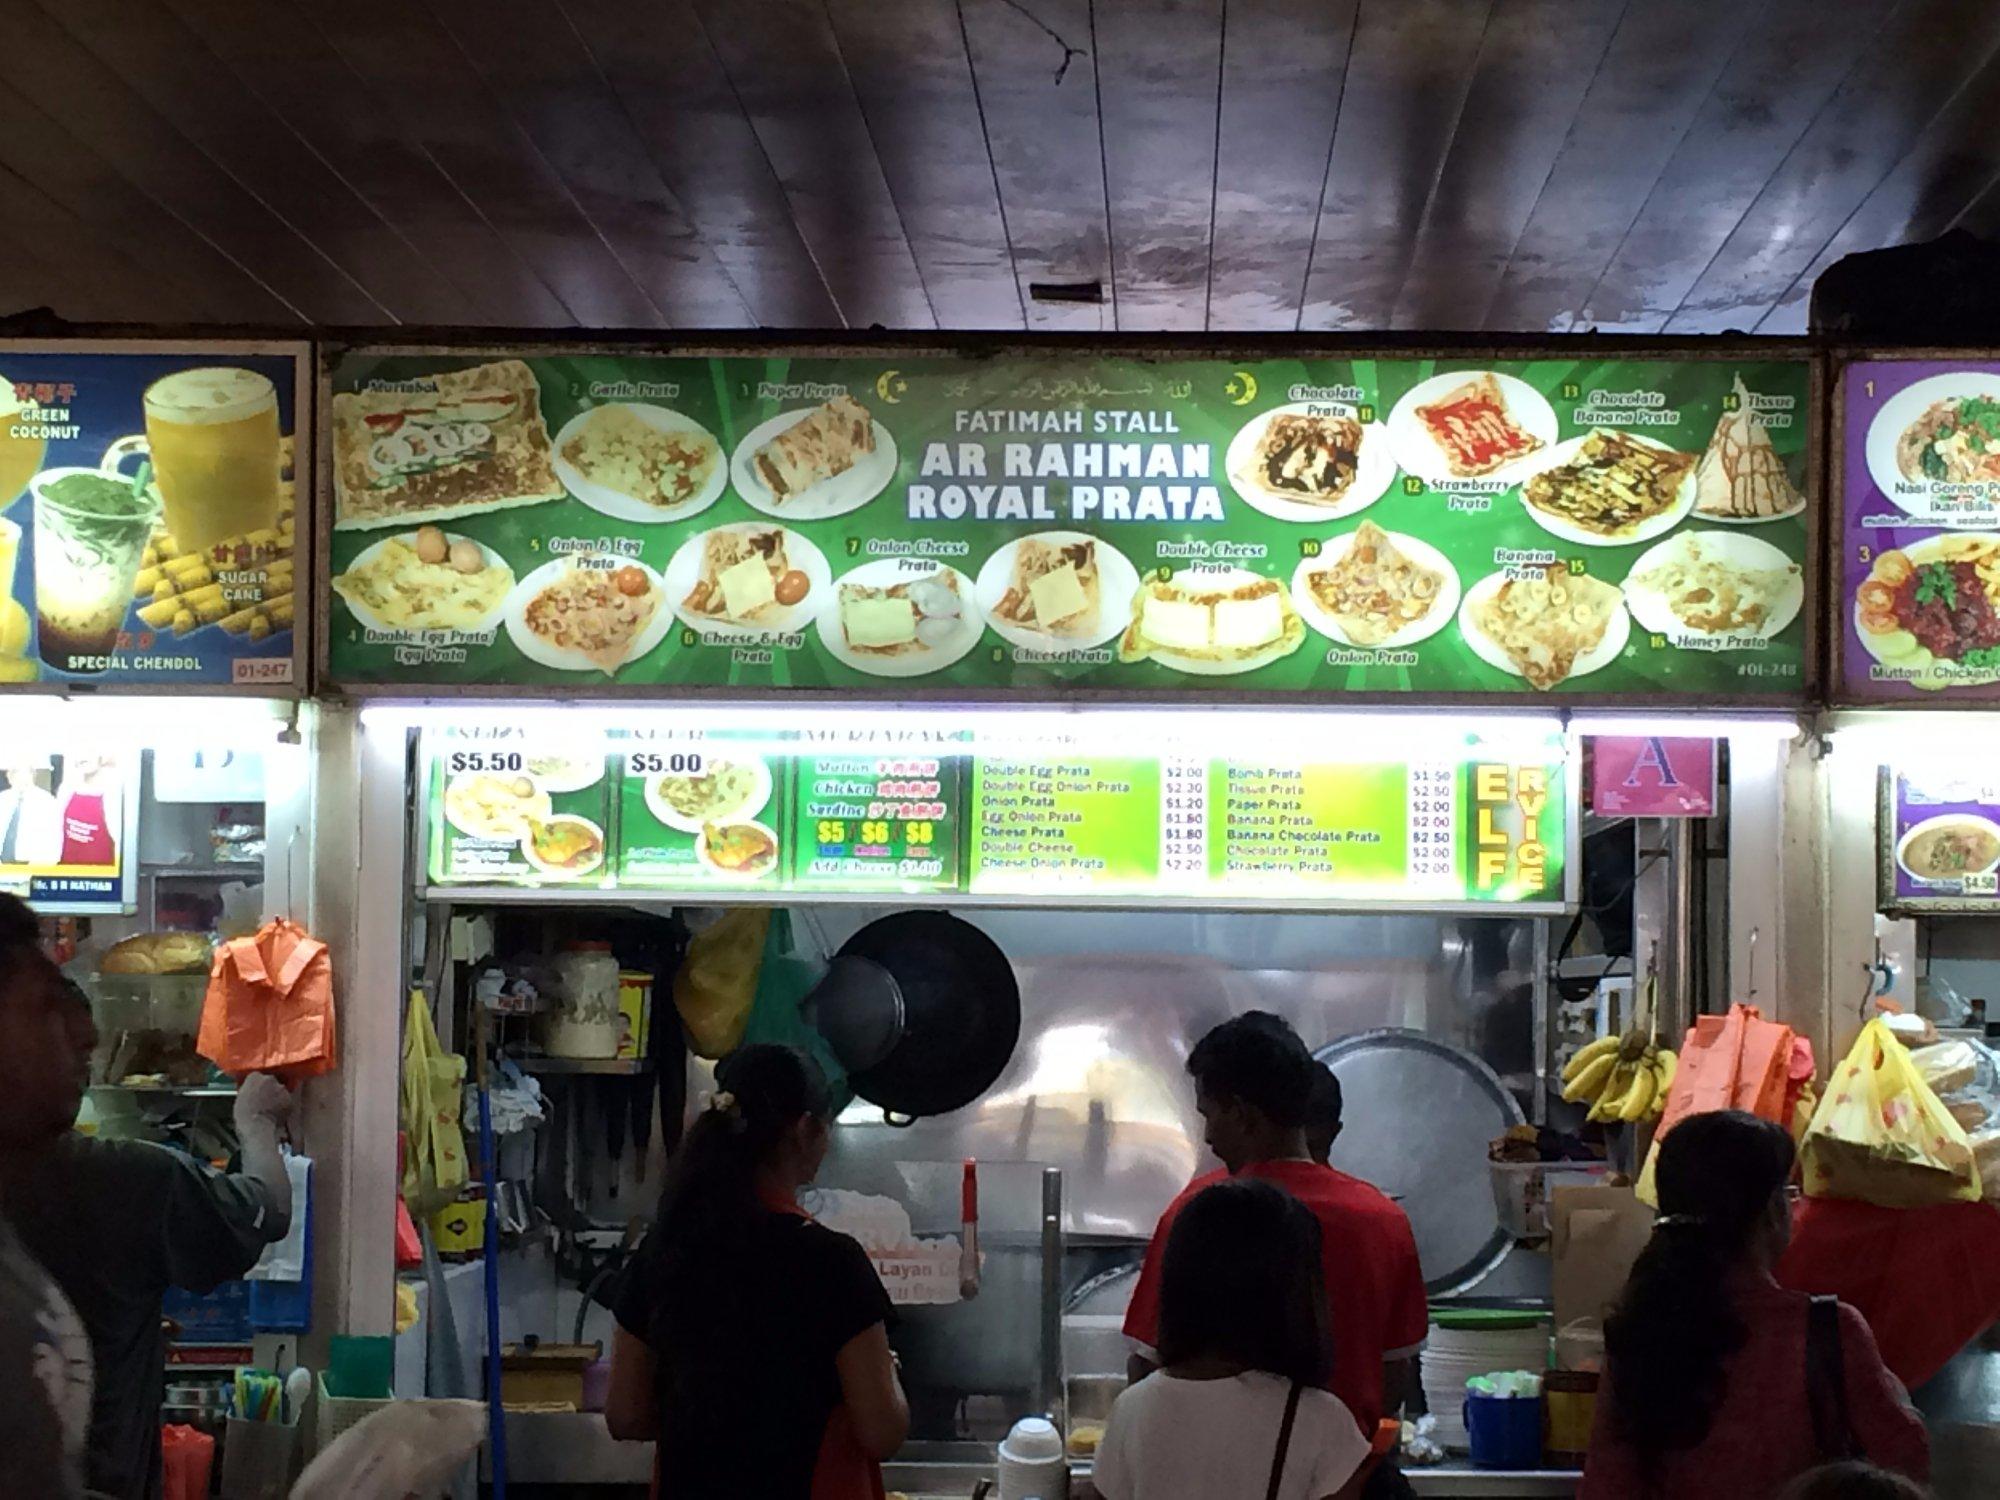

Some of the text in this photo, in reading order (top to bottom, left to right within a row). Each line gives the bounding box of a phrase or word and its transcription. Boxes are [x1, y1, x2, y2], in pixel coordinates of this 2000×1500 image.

[590, 382, 635, 396] Garlic
[637, 383, 679, 397] Prata
[759, 383, 801, 399] Paper
[804, 383, 845, 397] Prata
[1291, 386, 1362, 400] Chocolate
[1865, 382, 1874, 398] 1
[1590, 392, 1663, 405] Chocolate
[1750, 396, 1793, 408] Tissue
[21, 408, 69, 422] GREEN
[1307, 405, 1371, 420] Prata 11
[1576, 411, 1678, 423] Banana Prata
[955, 411, 1179, 433] FATIMAH STALL
[1751, 414, 1790, 426] Prata
[10, 425, 80, 439] COCONUT
[921, 443, 1209, 478] AR RAHMAN
[1407, 478, 1510, 493] 12 Strawberry
[1895, 482, 1926, 493] Nasi
[1931, 482, 1984, 496] Goreng
[908, 485, 1225, 520] ROYAL PRATA
[1451, 497, 1489, 509] Prata
[551, 539, 592, 550] Onion
[600, 539, 609, 550] &
[616, 539, 640, 555] Egg
[868, 540, 911, 553] Onion
[916, 541, 968, 554] Cheese
[1158, 543, 1265, 556] Double Cheese
[1304, 543, 1318, 554] 10
[1496, 549, 1553, 561] Banana
[1859, 547, 1870, 562] 3
[577, 557, 615, 569] Prata
[899, 559, 937, 571] Prata
[1160, 561, 1231, 580] 9 Prata
[1506, 560, 1584, 580] Prata 15
[219, 571, 267, 584] SUGAR
[223, 588, 262, 601] CANE
[366, 630, 414, 643] Double
[421, 630, 445, 645] Egg
[703, 632, 754, 645] Cheese
[778, 632, 801, 649] Egg
[1678, 636, 1721, 649] Honey
[1727, 636, 1766, 648] Prata
[426, 649, 465, 661] Prata
[734, 650, 773, 662] Prata
[1015, 649, 1066, 662] Cheese
[1071, 650, 1109, 662] Prata
[1329, 651, 1417, 663] Onion Prata
[68, 656, 202, 670] SPECIAL CHENDOL
[237, 663, 288, 678] 01-247
[1871, 667, 1922, 678] Mutton
[1934, 667, 1990, 678] Chicken
[452, 752, 522, 771] $5.50
[632, 753, 701, 772] $5.00
[1622, 737, 1681, 787] A
[983, 765, 1025, 776] Double
[1030, 766, 1052, 778] Egg
[1057, 766, 1090, 777] Prata
[1269, 769, 1301, 779] Prata
[815, 782, 873, 794] Chicken
[983, 780, 1025, 791] Double
[1030, 781, 1052, 793] Egg
[1057, 781, 1092, 792] Onion
[1097, 781, 1130, 792] Prata
[1229, 783, 1266, 794] Tissue
[1271, 784, 1304, 795] Prata
[982, 796, 1017, 807] Onion
[1022, 796, 1055, 807] Prata
[1227, 799, 1263, 811] Paper
[1268, 799, 1301, 810] Prata
[809, 803, 862, 816] Sardine
[982, 811, 1004, 823] Egg
[1009, 811, 1044, 822] Onion
[1049, 811, 1082, 822] Prata
[1227, 814, 1274, 825] Banana
[1280, 815, 1313, 825] Prata
[982, 826, 1026, 837] Cheese
[1032, 826, 1064, 838] Prata
[1477, 765, 1508, 889] ELF
[1517, 765, 1546, 890] RVICE
[1227, 829, 1274, 840] Banana
[1279, 830, 1342, 841] Chocolate
[1346, 831, 1381, 842] Prata
[982, 841, 1024, 852] Double
[1028, 842, 1074, 853] Cheese
[1227, 845, 1288, 856] Chocolate
[1294, 845, 1327, 856] Prata
[982, 857, 1026, 868] Cheese
[1031, 858, 1066, 868] Onion
[1071, 858, 1104, 869] Prata
[1227, 860, 1293, 872] Strawberry
[1299, 861, 1332, 872] Prata
[70, 881, 112, 891] NATHAN
[880, 1262, 932, 1279] Layan
